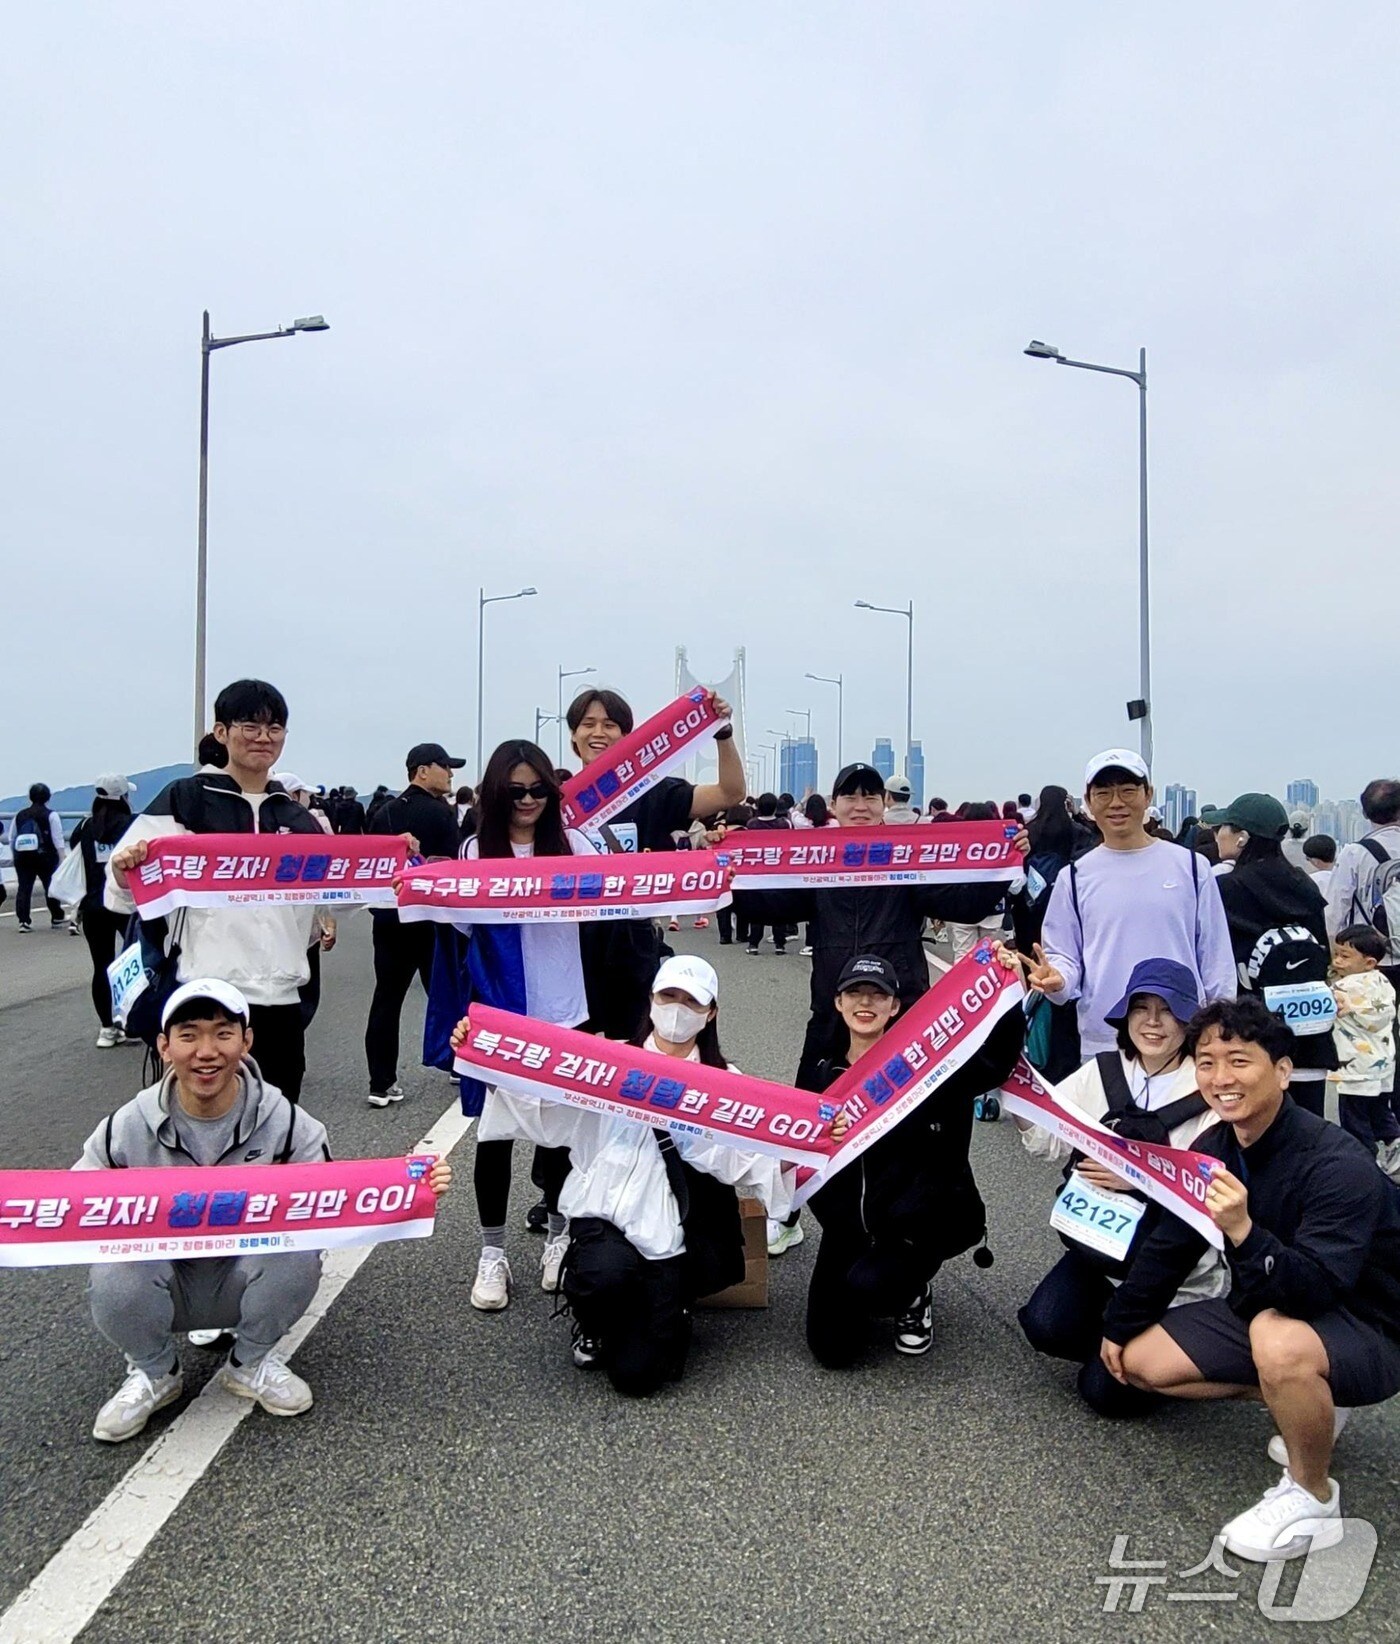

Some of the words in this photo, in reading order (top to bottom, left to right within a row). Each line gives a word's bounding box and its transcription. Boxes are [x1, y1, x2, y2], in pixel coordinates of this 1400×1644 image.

[636, 732, 671, 768] 길만
[673, 704, 708, 738] GO!
[140, 855, 208, 886] 북구랑
[212, 856, 270, 879] 걷자!
[354, 857, 397, 879] 길만
[789, 845, 836, 865] 걷자!
[918, 843, 961, 864] 길만
[966, 842, 1010, 861] GO!
[488, 876, 541, 897] 걷자!
[631, 873, 675, 897] 길만
[682, 870, 724, 891] GO!
[922, 1005, 965, 1051] 길만
[961, 966, 1001, 1013] GO!
[1276, 997, 1334, 1019] 42092
[472, 1029, 551, 1070] 북구랑
[552, 1051, 618, 1087] 걷자!
[710, 1097, 766, 1130] 길만
[768, 1113, 824, 1144] GO!
[79, 1195, 159, 1227] 걷자!
[285, 1188, 348, 1221] 길만
[355, 1184, 416, 1213] GO!
[1062, 1191, 1132, 1234] 42127
